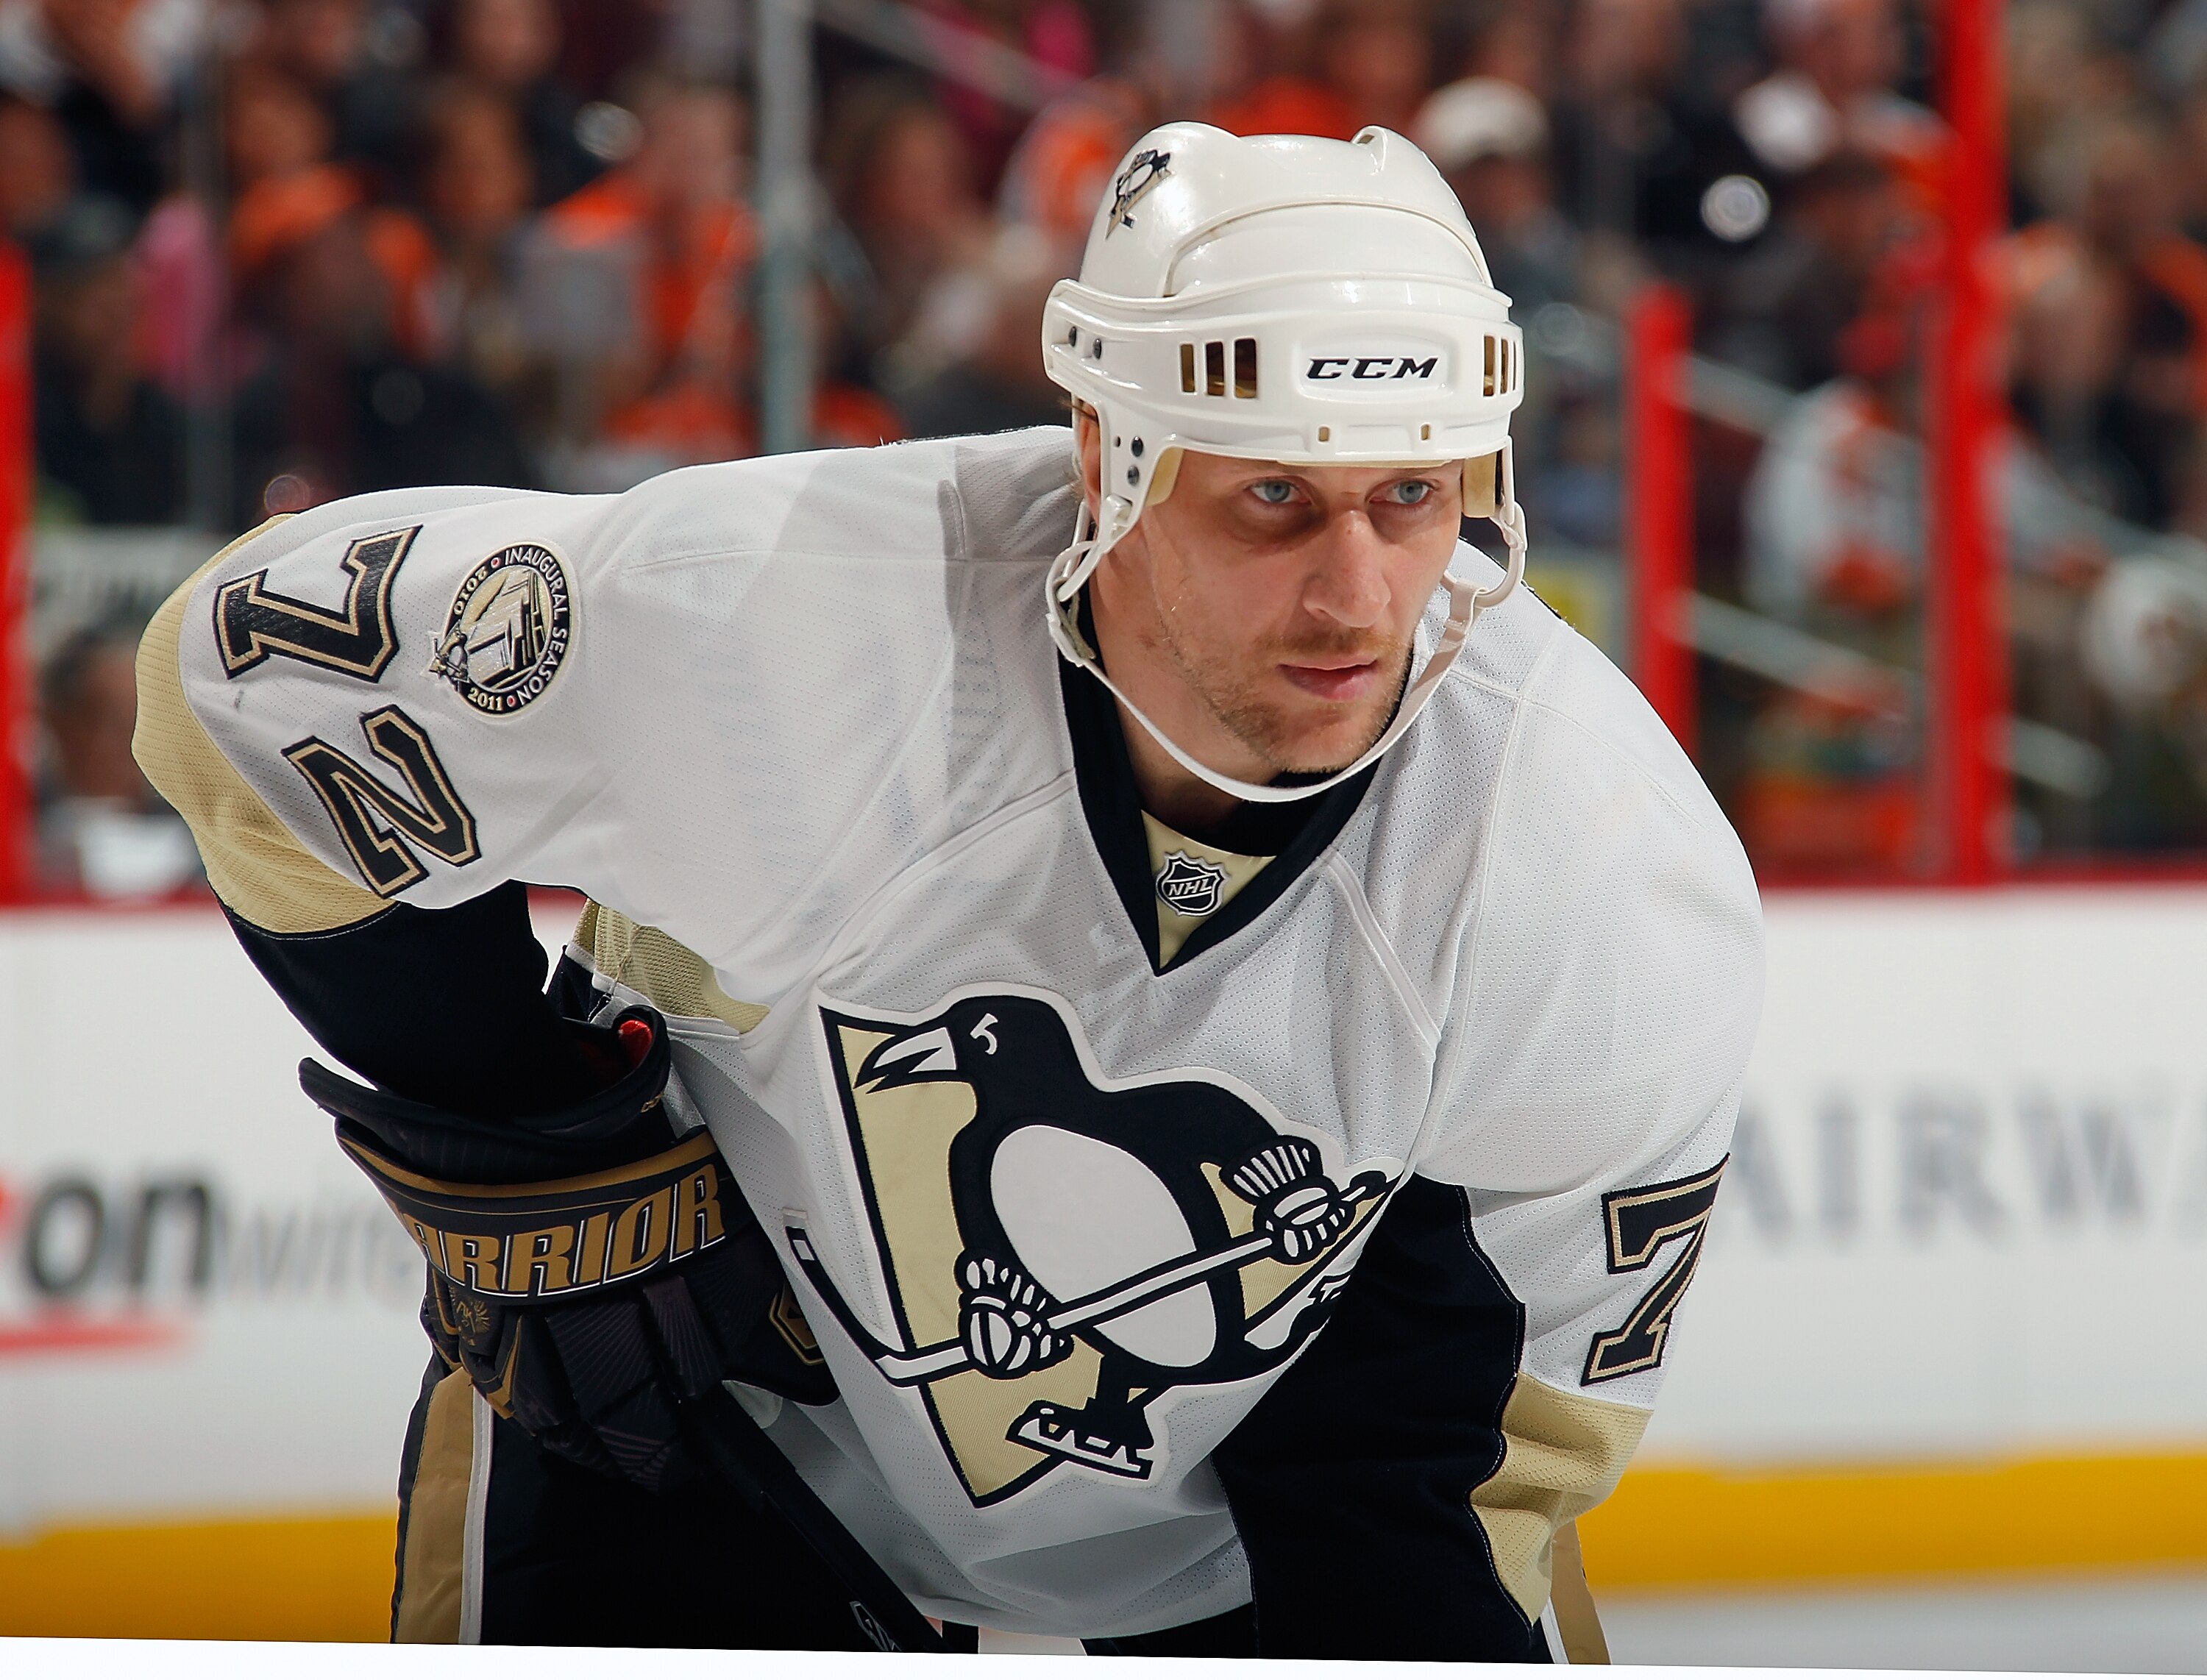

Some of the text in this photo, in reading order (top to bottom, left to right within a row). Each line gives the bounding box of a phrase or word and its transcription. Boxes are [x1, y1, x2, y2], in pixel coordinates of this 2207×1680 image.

[1306, 357, 1438, 380] CCM
[453, 566, 488, 616] 2010
[505, 546, 568, 705] INAUGURAL SEASON
[213, 524, 482, 899] 72
[467, 686, 503, 711] 2011
[1168, 878, 1212, 897] NHL
[395, 1163, 726, 1298] ARRIOR
[1718, 1085, 2207, 1245] AIRW
[0, 1170, 222, 1306] on
[1581, 1152, 1730, 1386] 7
